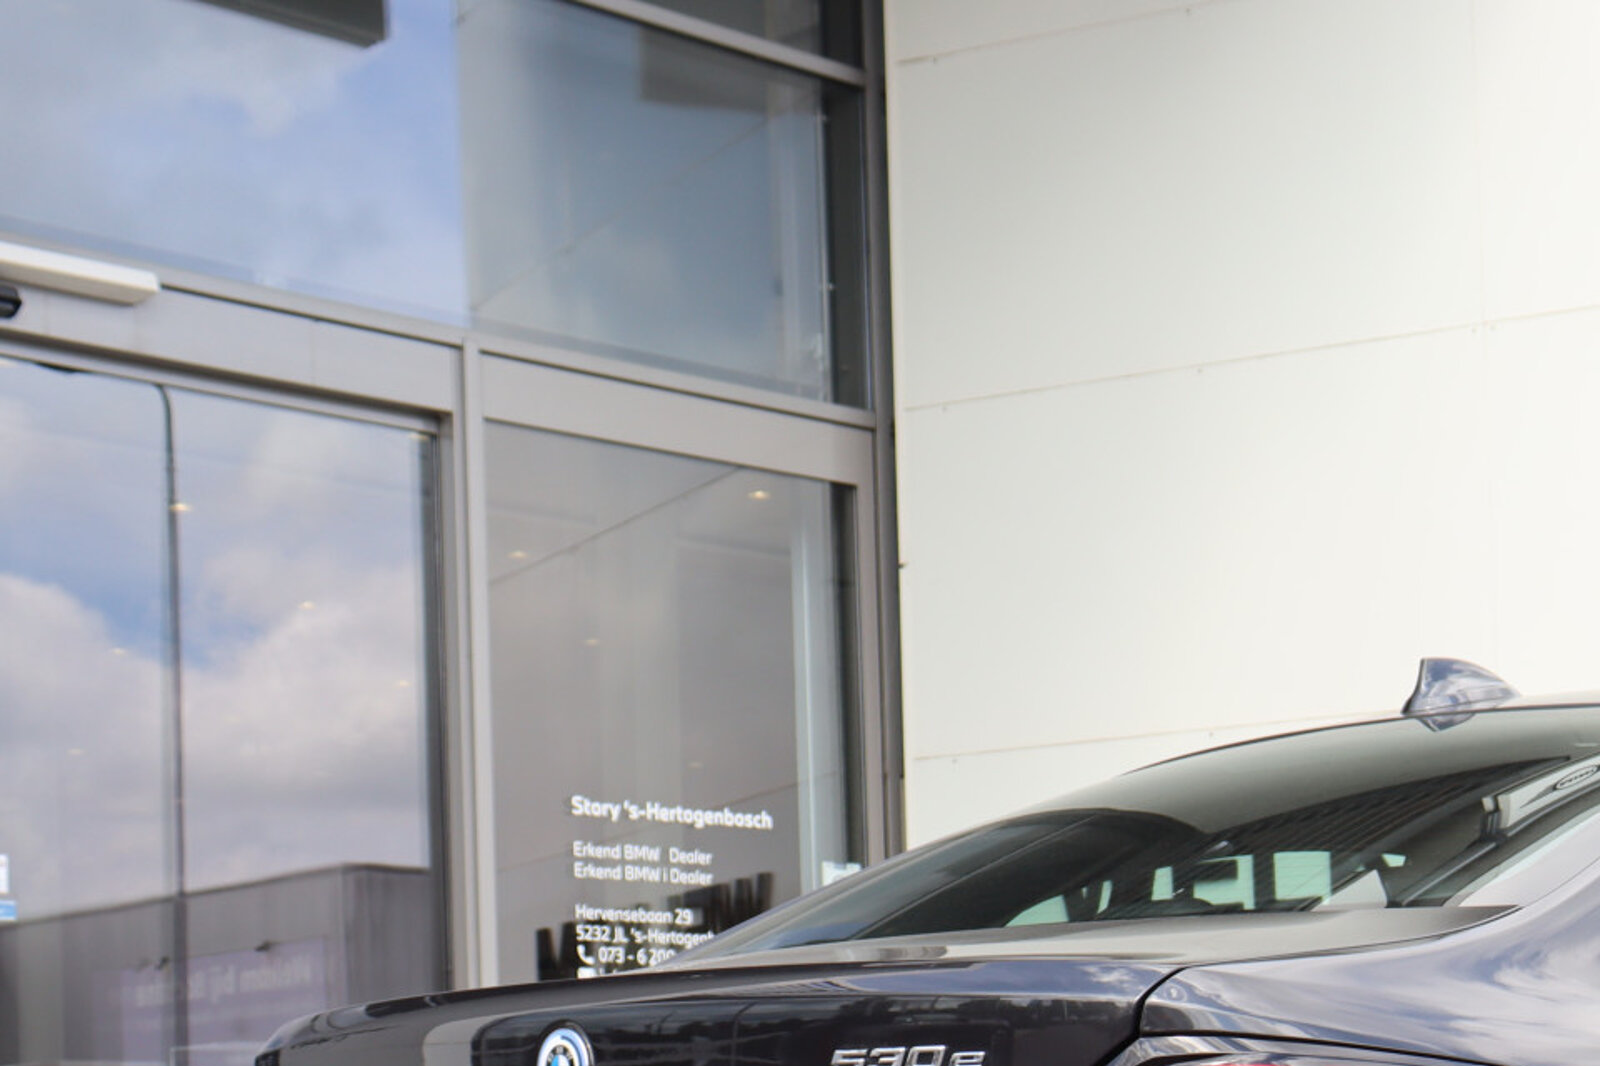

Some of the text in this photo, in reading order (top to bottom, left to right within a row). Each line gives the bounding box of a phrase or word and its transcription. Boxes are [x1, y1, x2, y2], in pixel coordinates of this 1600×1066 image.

[571, 795, 774, 830] Story 's-Hertogenbosch
[573, 841, 713, 866] Erkend BMW Dealer
[573, 861, 713, 886] Erkend BMW i Dealer
[575, 903, 694, 926] Hervensebaan 29
[576, 923, 611, 942] 5232
[598, 946, 625, 964] 073
[636, 947, 647, 966] 6
